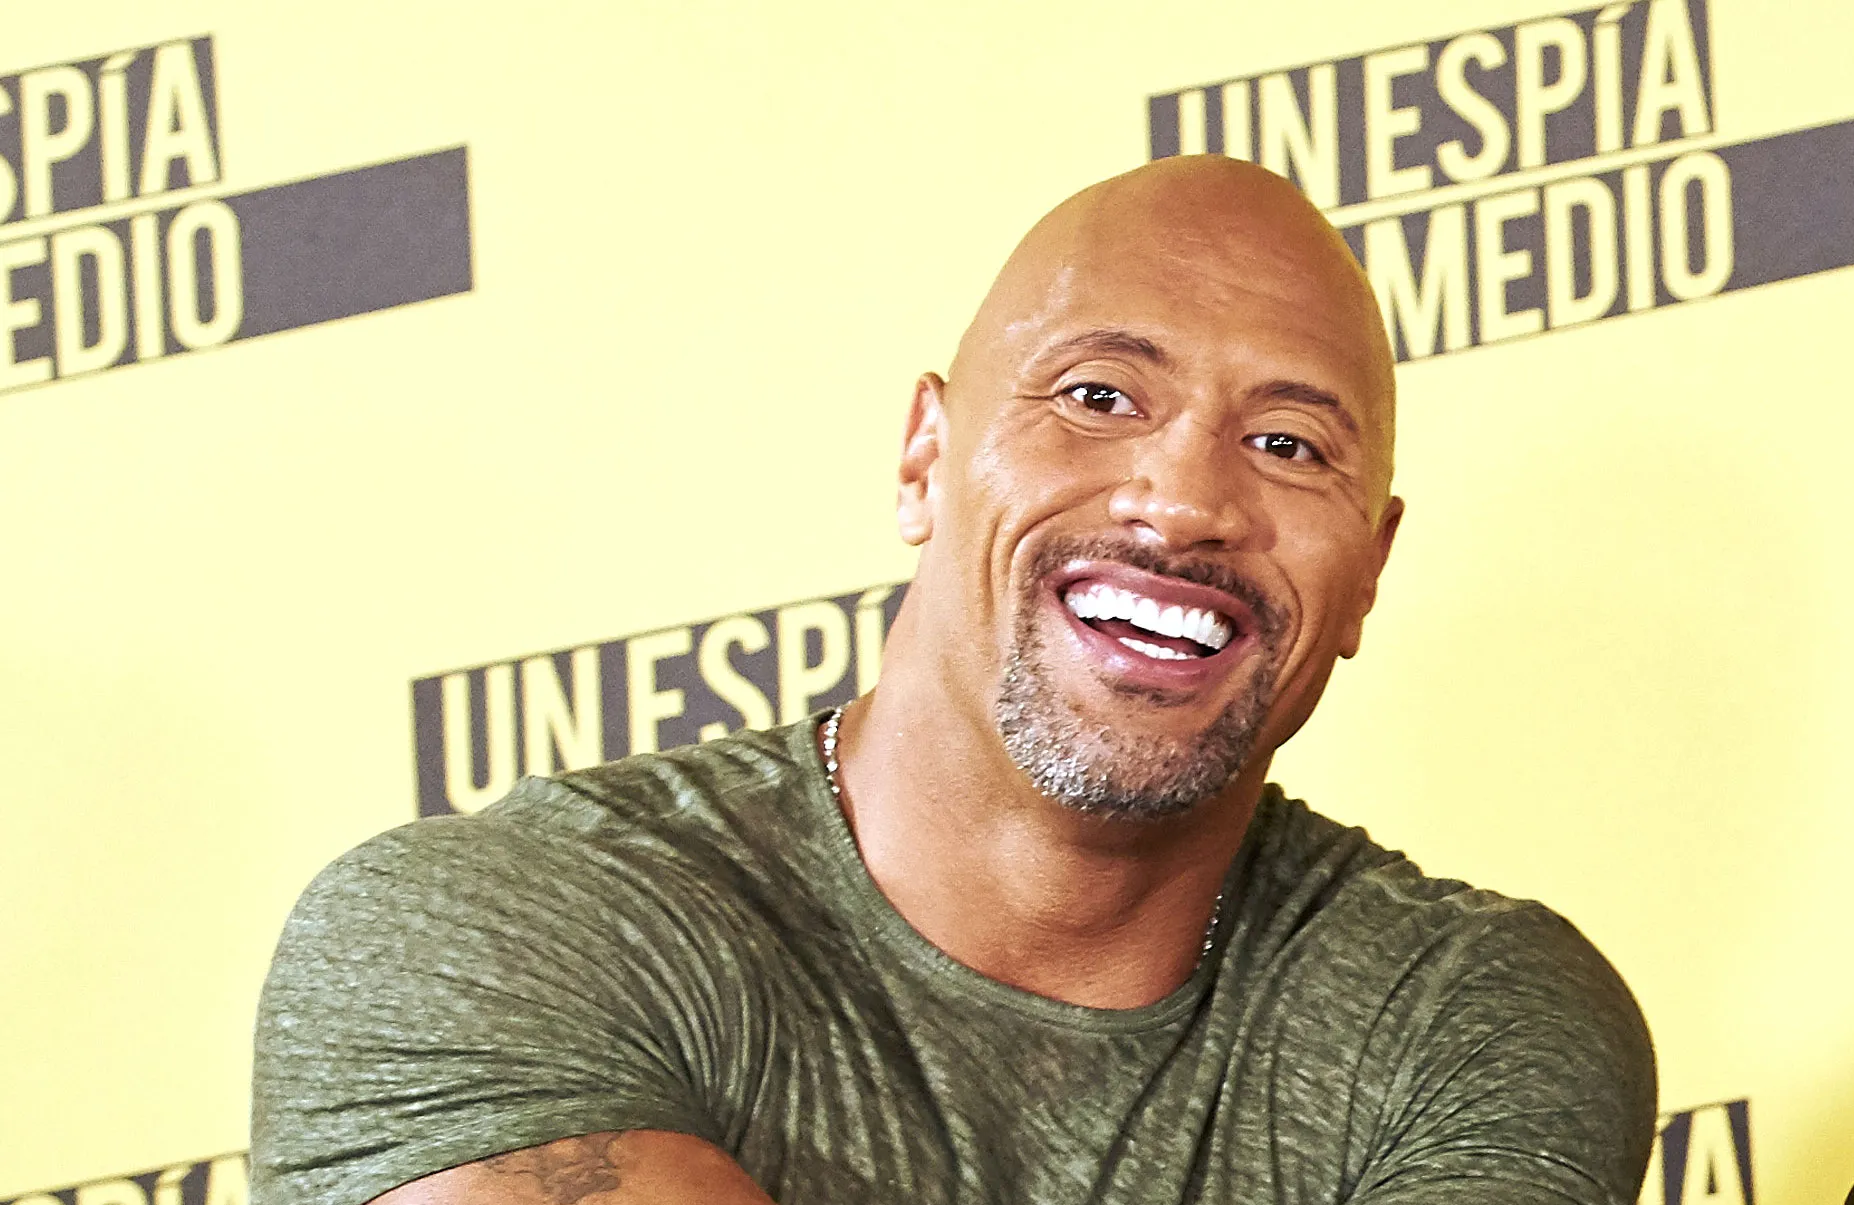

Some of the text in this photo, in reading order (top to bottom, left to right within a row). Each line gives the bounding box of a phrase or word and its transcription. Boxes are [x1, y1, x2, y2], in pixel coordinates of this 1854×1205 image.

[0, 40, 217, 222] PÍA
[1364, 0, 1709, 198] ESPÍA
[1365, 150, 1735, 361] MEDIO
[441, 650, 603, 815] UN
